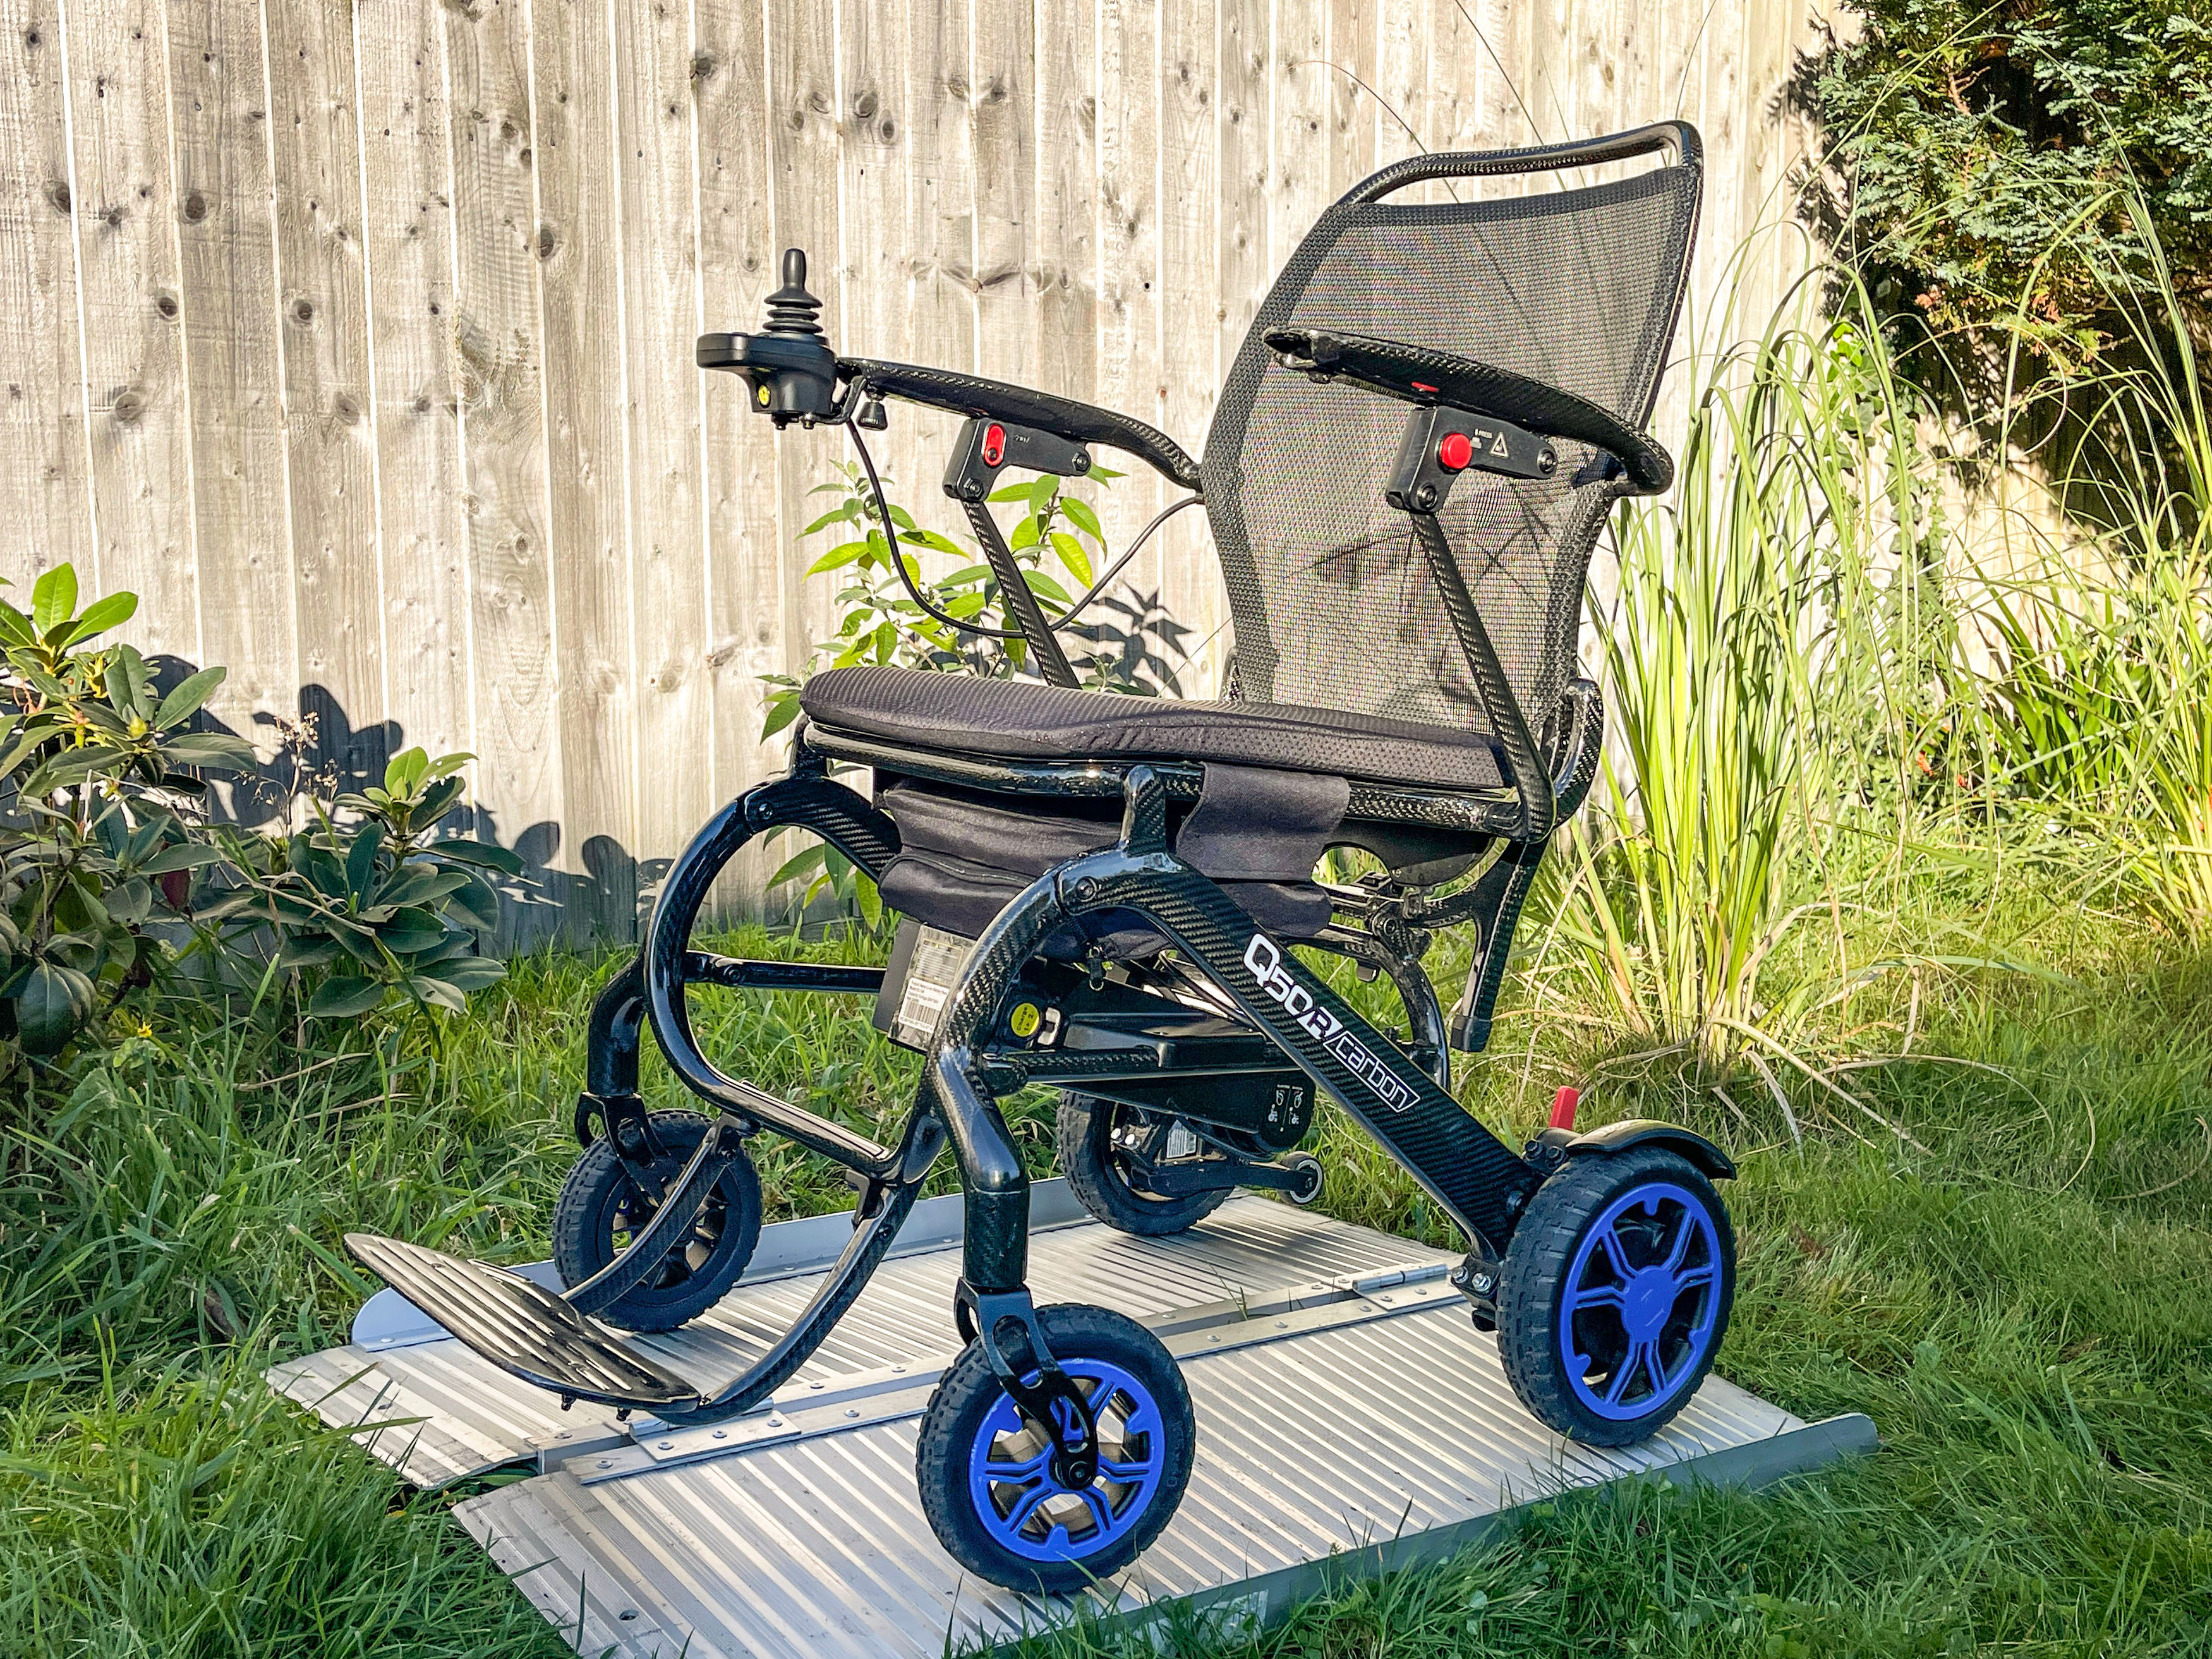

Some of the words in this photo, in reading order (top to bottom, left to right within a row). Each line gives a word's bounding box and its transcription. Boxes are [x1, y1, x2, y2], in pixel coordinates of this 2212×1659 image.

[1017, 1007, 1027, 1030] Charge
[1243, 934, 1343, 1039] Q50R
[1336, 1036, 1407, 1108] carbon
